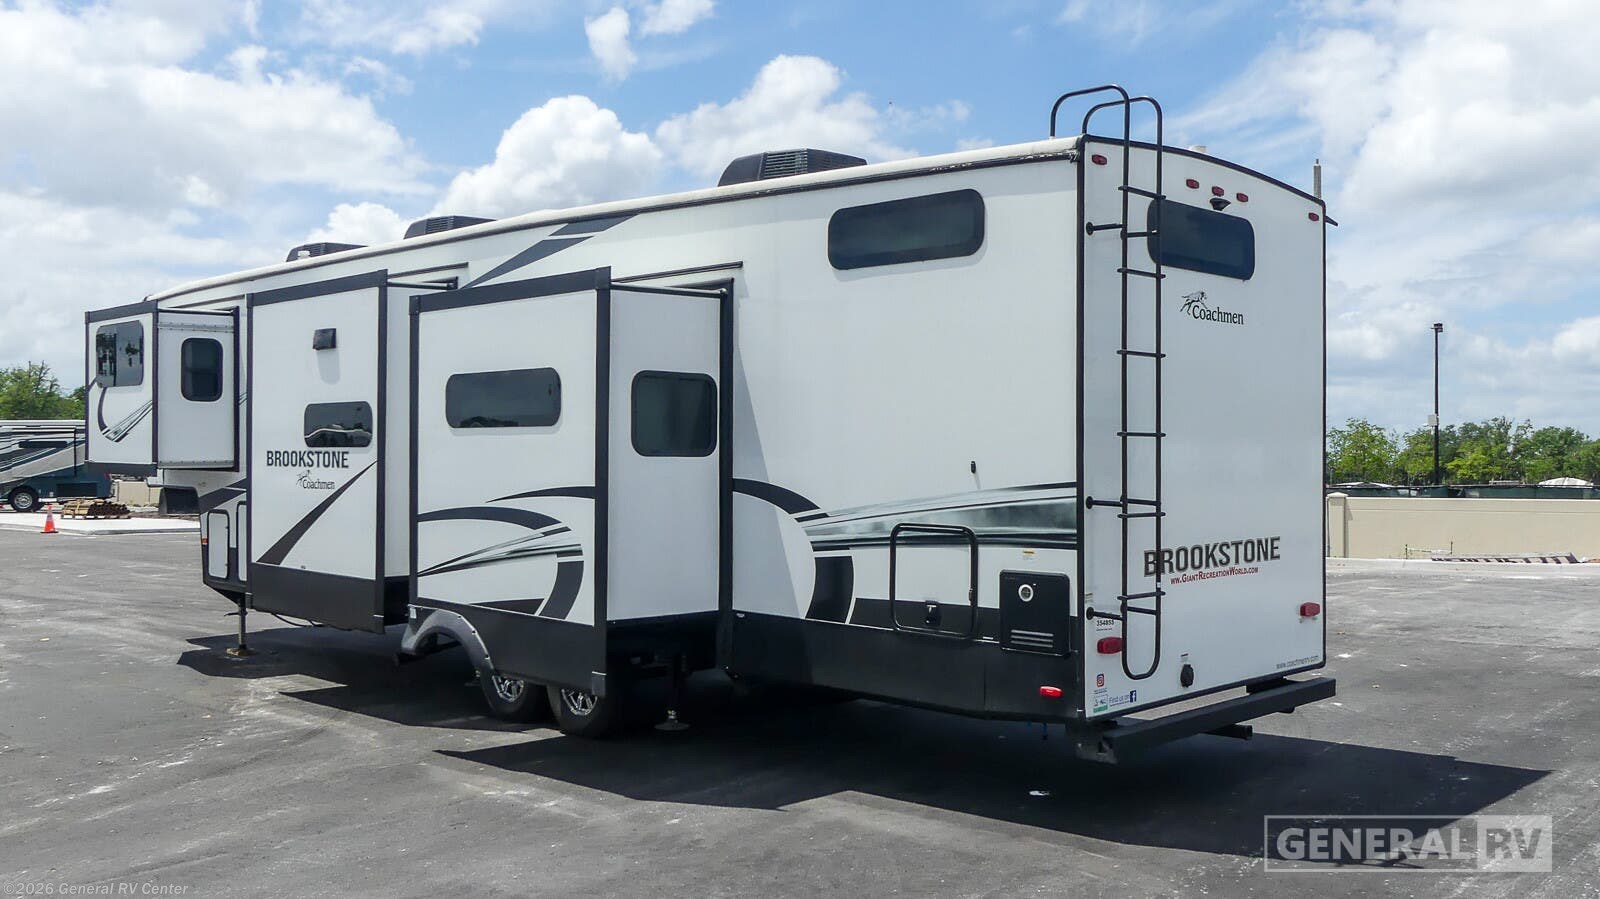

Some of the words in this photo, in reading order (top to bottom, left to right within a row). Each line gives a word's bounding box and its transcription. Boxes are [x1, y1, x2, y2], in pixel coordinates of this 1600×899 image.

[1192, 304, 1244, 325] Coachmen
[266, 450, 350, 469] BROOKSTONE
[302, 479, 336, 490] Coachmen
[1143, 536, 1281, 577] BROOKSTONE
